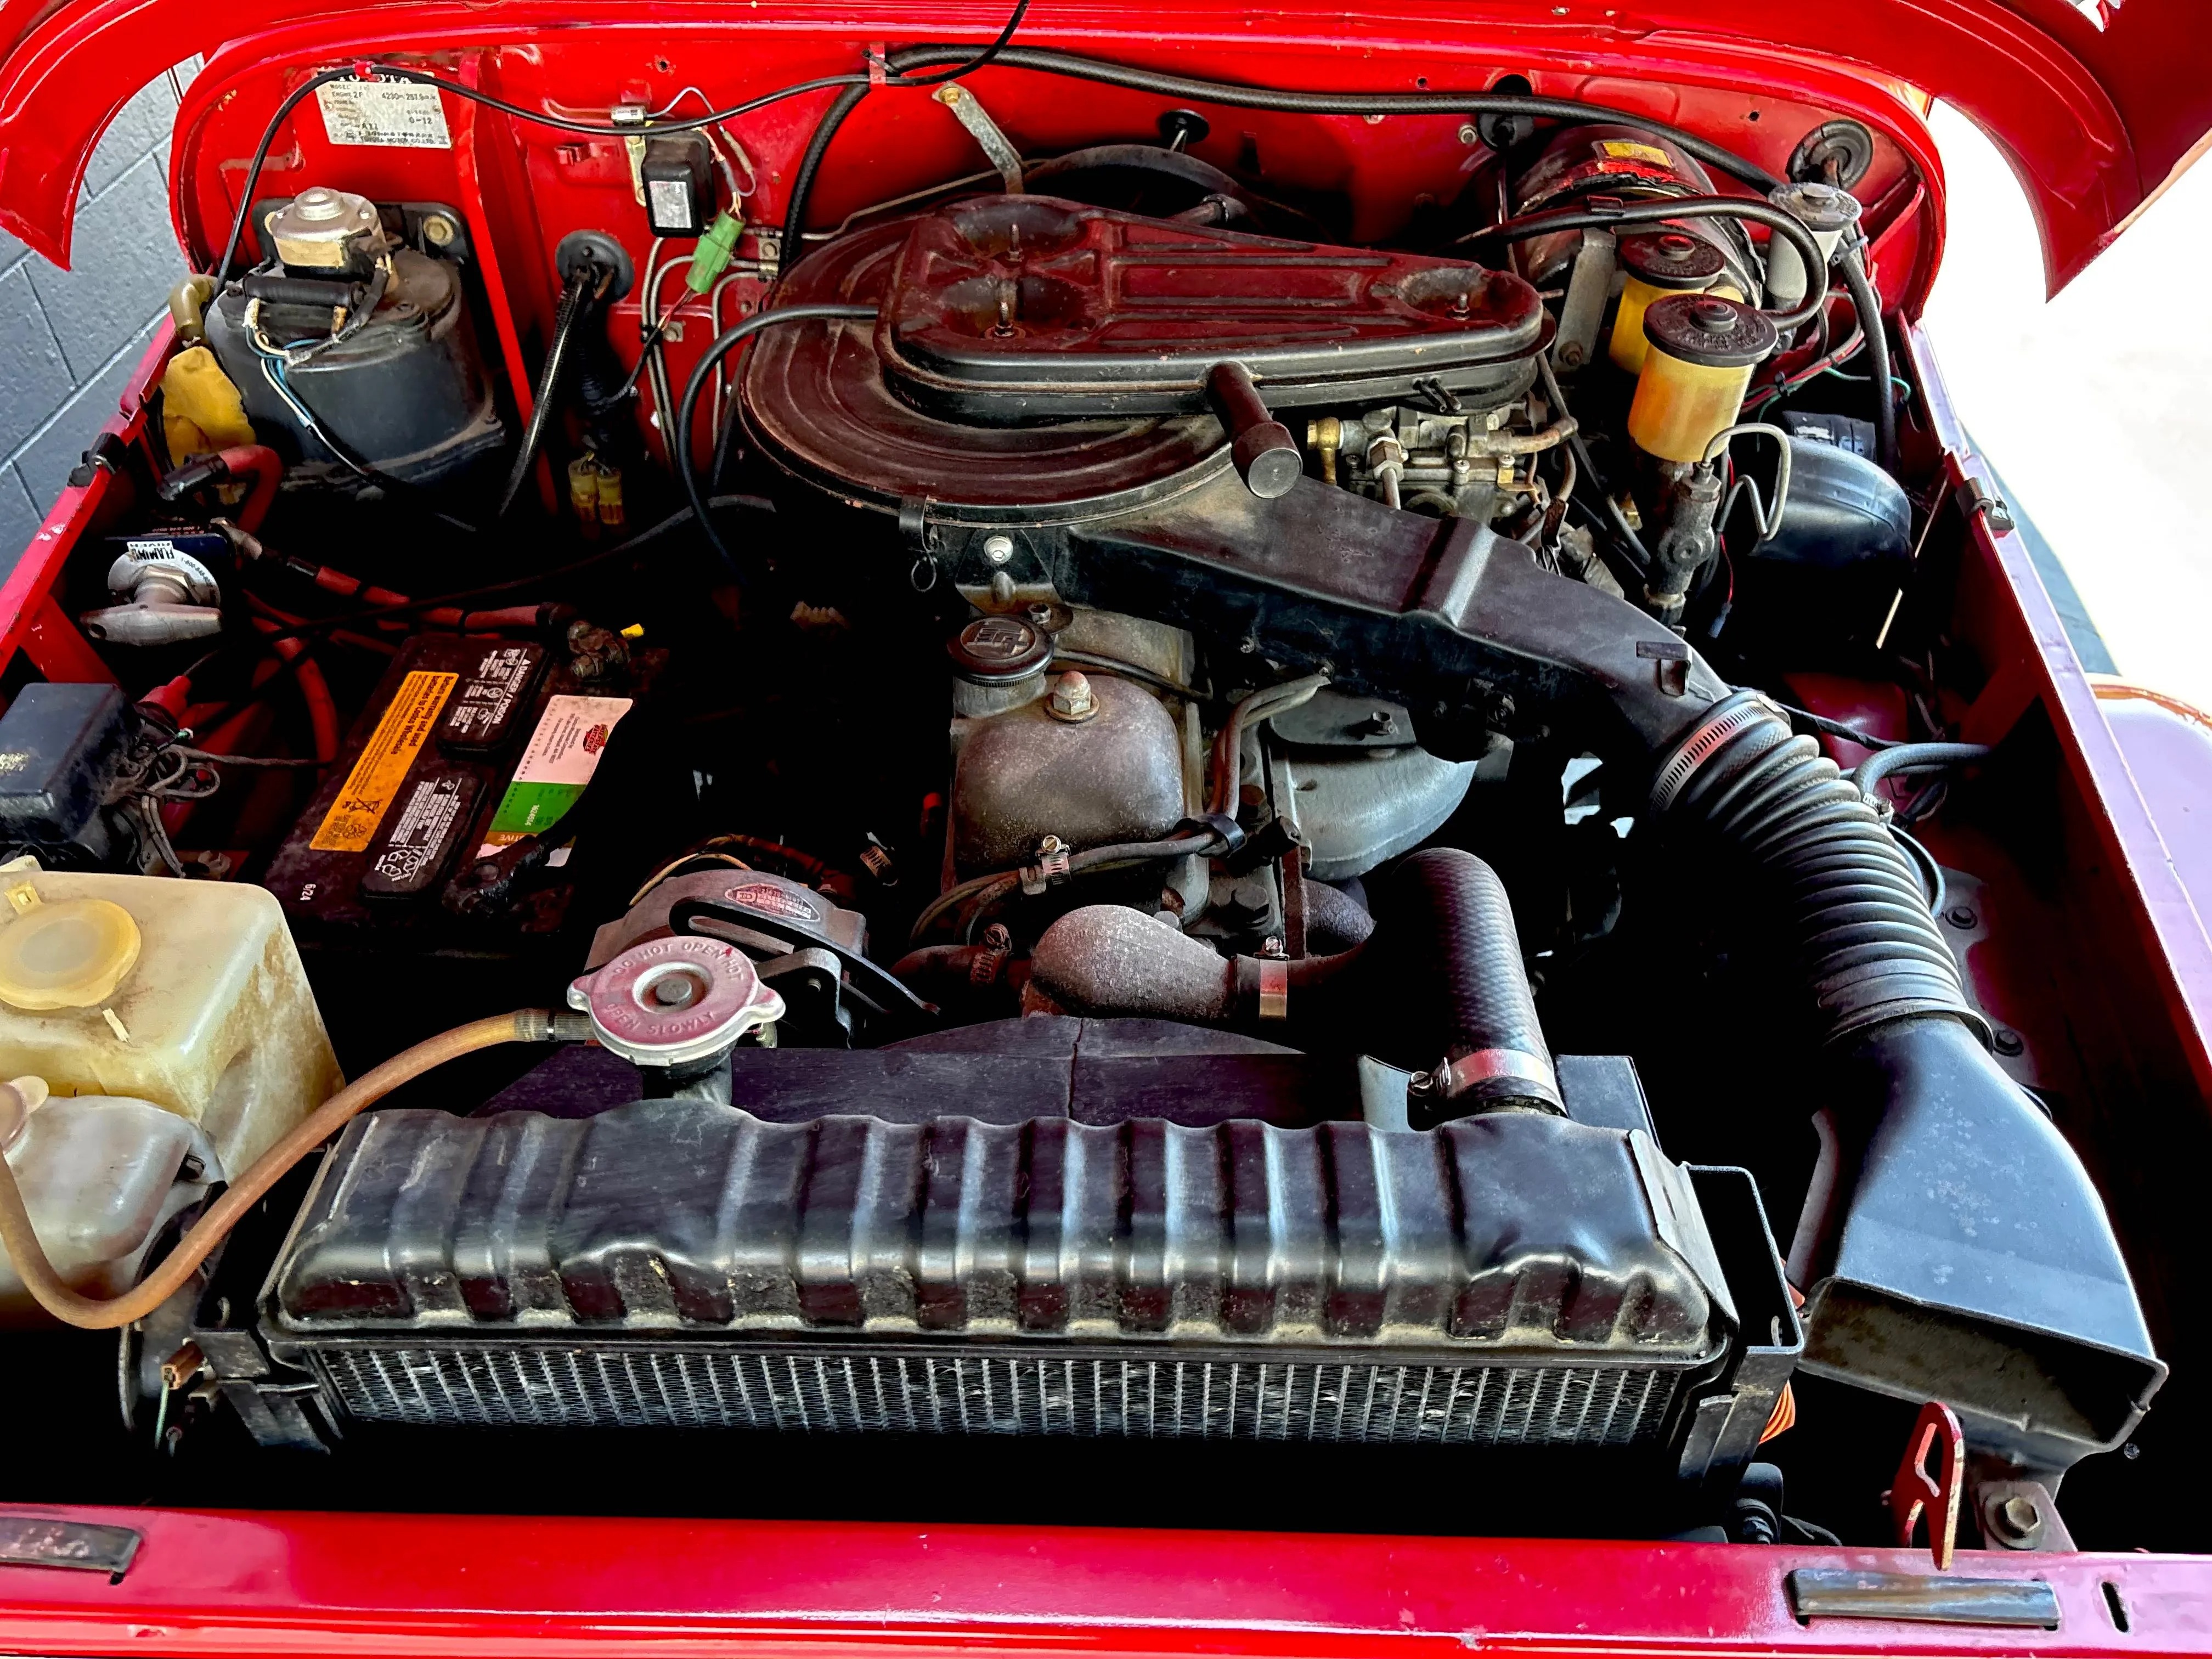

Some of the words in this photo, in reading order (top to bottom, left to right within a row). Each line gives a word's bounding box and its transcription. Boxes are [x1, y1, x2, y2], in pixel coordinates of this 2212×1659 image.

[508, 665, 528, 693] DANGER
[492, 698, 512, 724] POISON
[300, 884, 317, 901] 6/24
[613, 960, 636, 974] DO
[639, 943, 674, 960] NOT
[682, 941, 727, 961] OPEN
[721, 960, 745, 981] HOT
[605, 1003, 641, 1030] OPEN
[647, 1011, 716, 1035] SLOWLY
